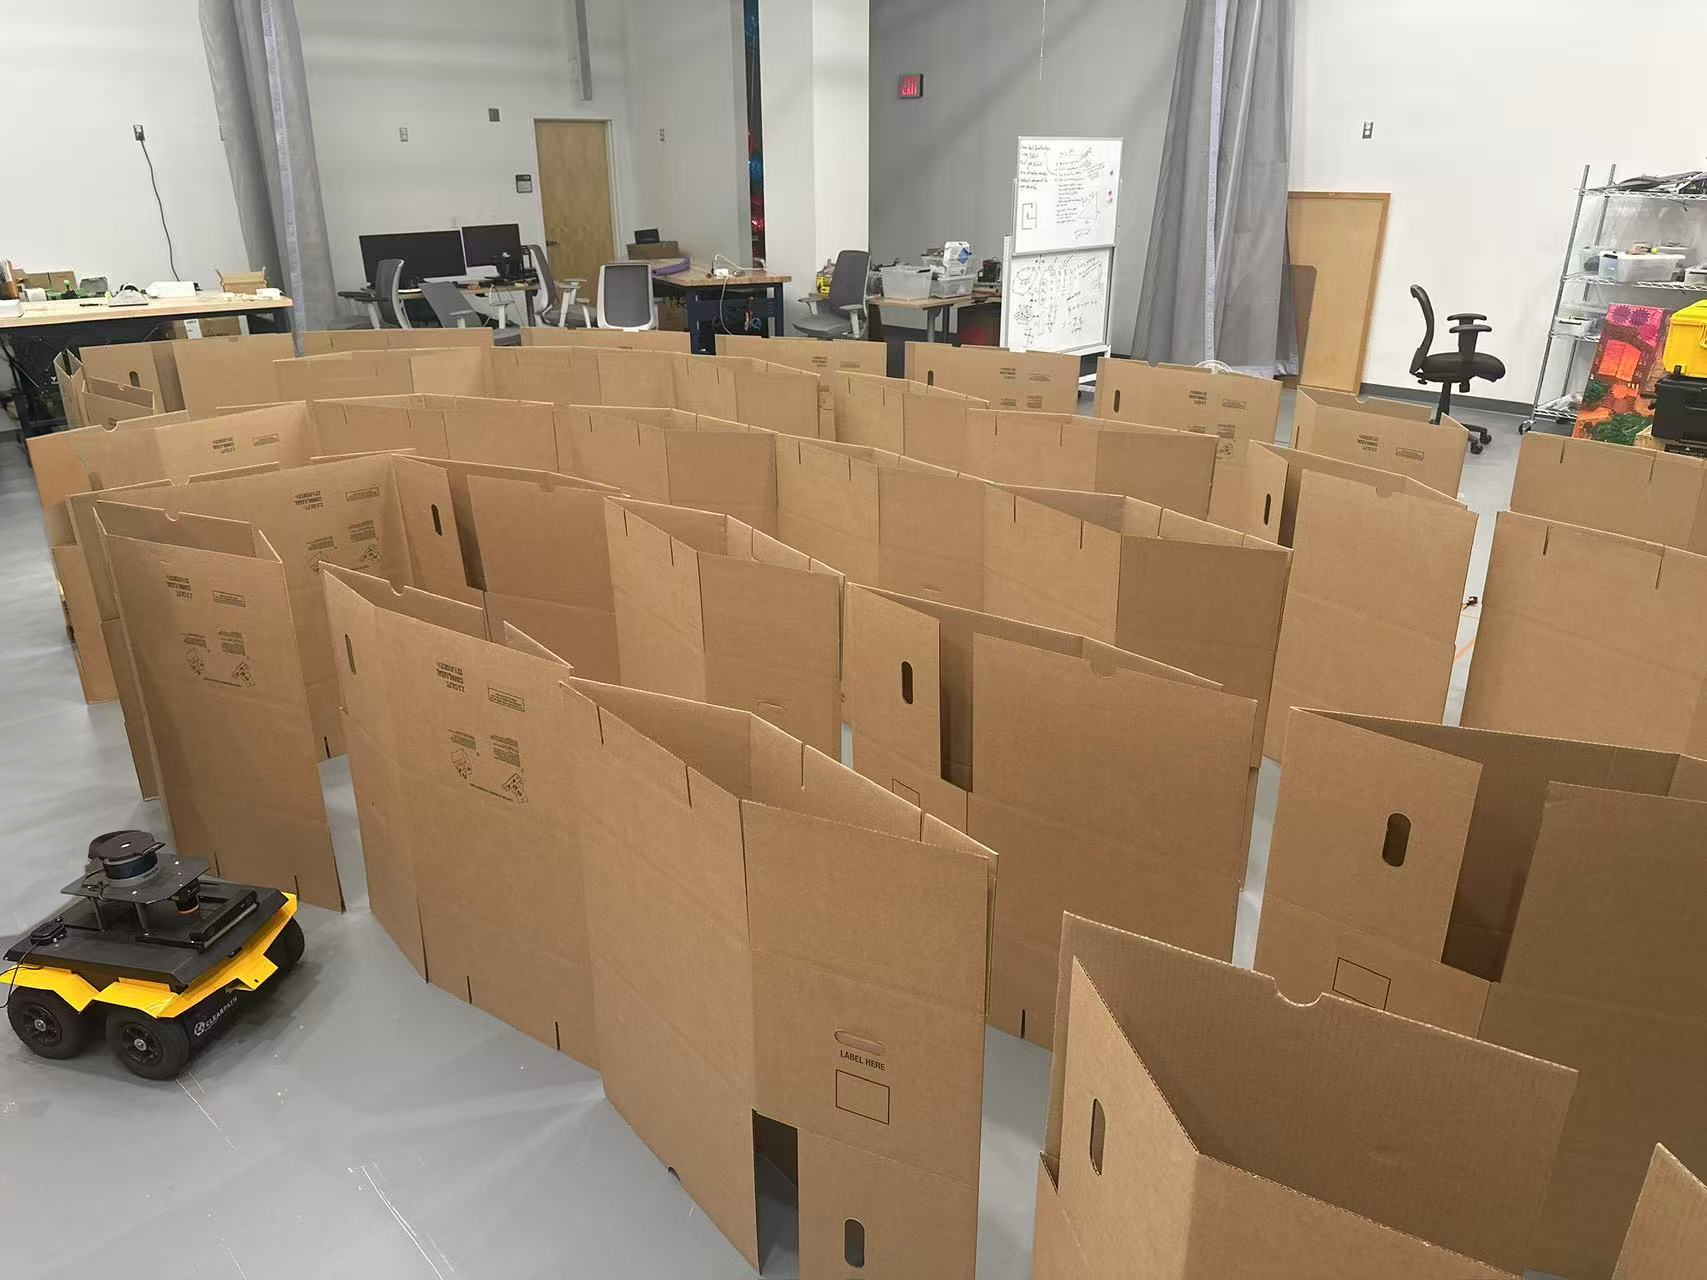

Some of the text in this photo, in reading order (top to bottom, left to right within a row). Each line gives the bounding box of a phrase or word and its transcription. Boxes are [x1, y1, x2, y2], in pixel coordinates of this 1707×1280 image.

[206, 995, 238, 1027] CLEARPATH
[840, 1049, 886, 1071] LABEL HERE
